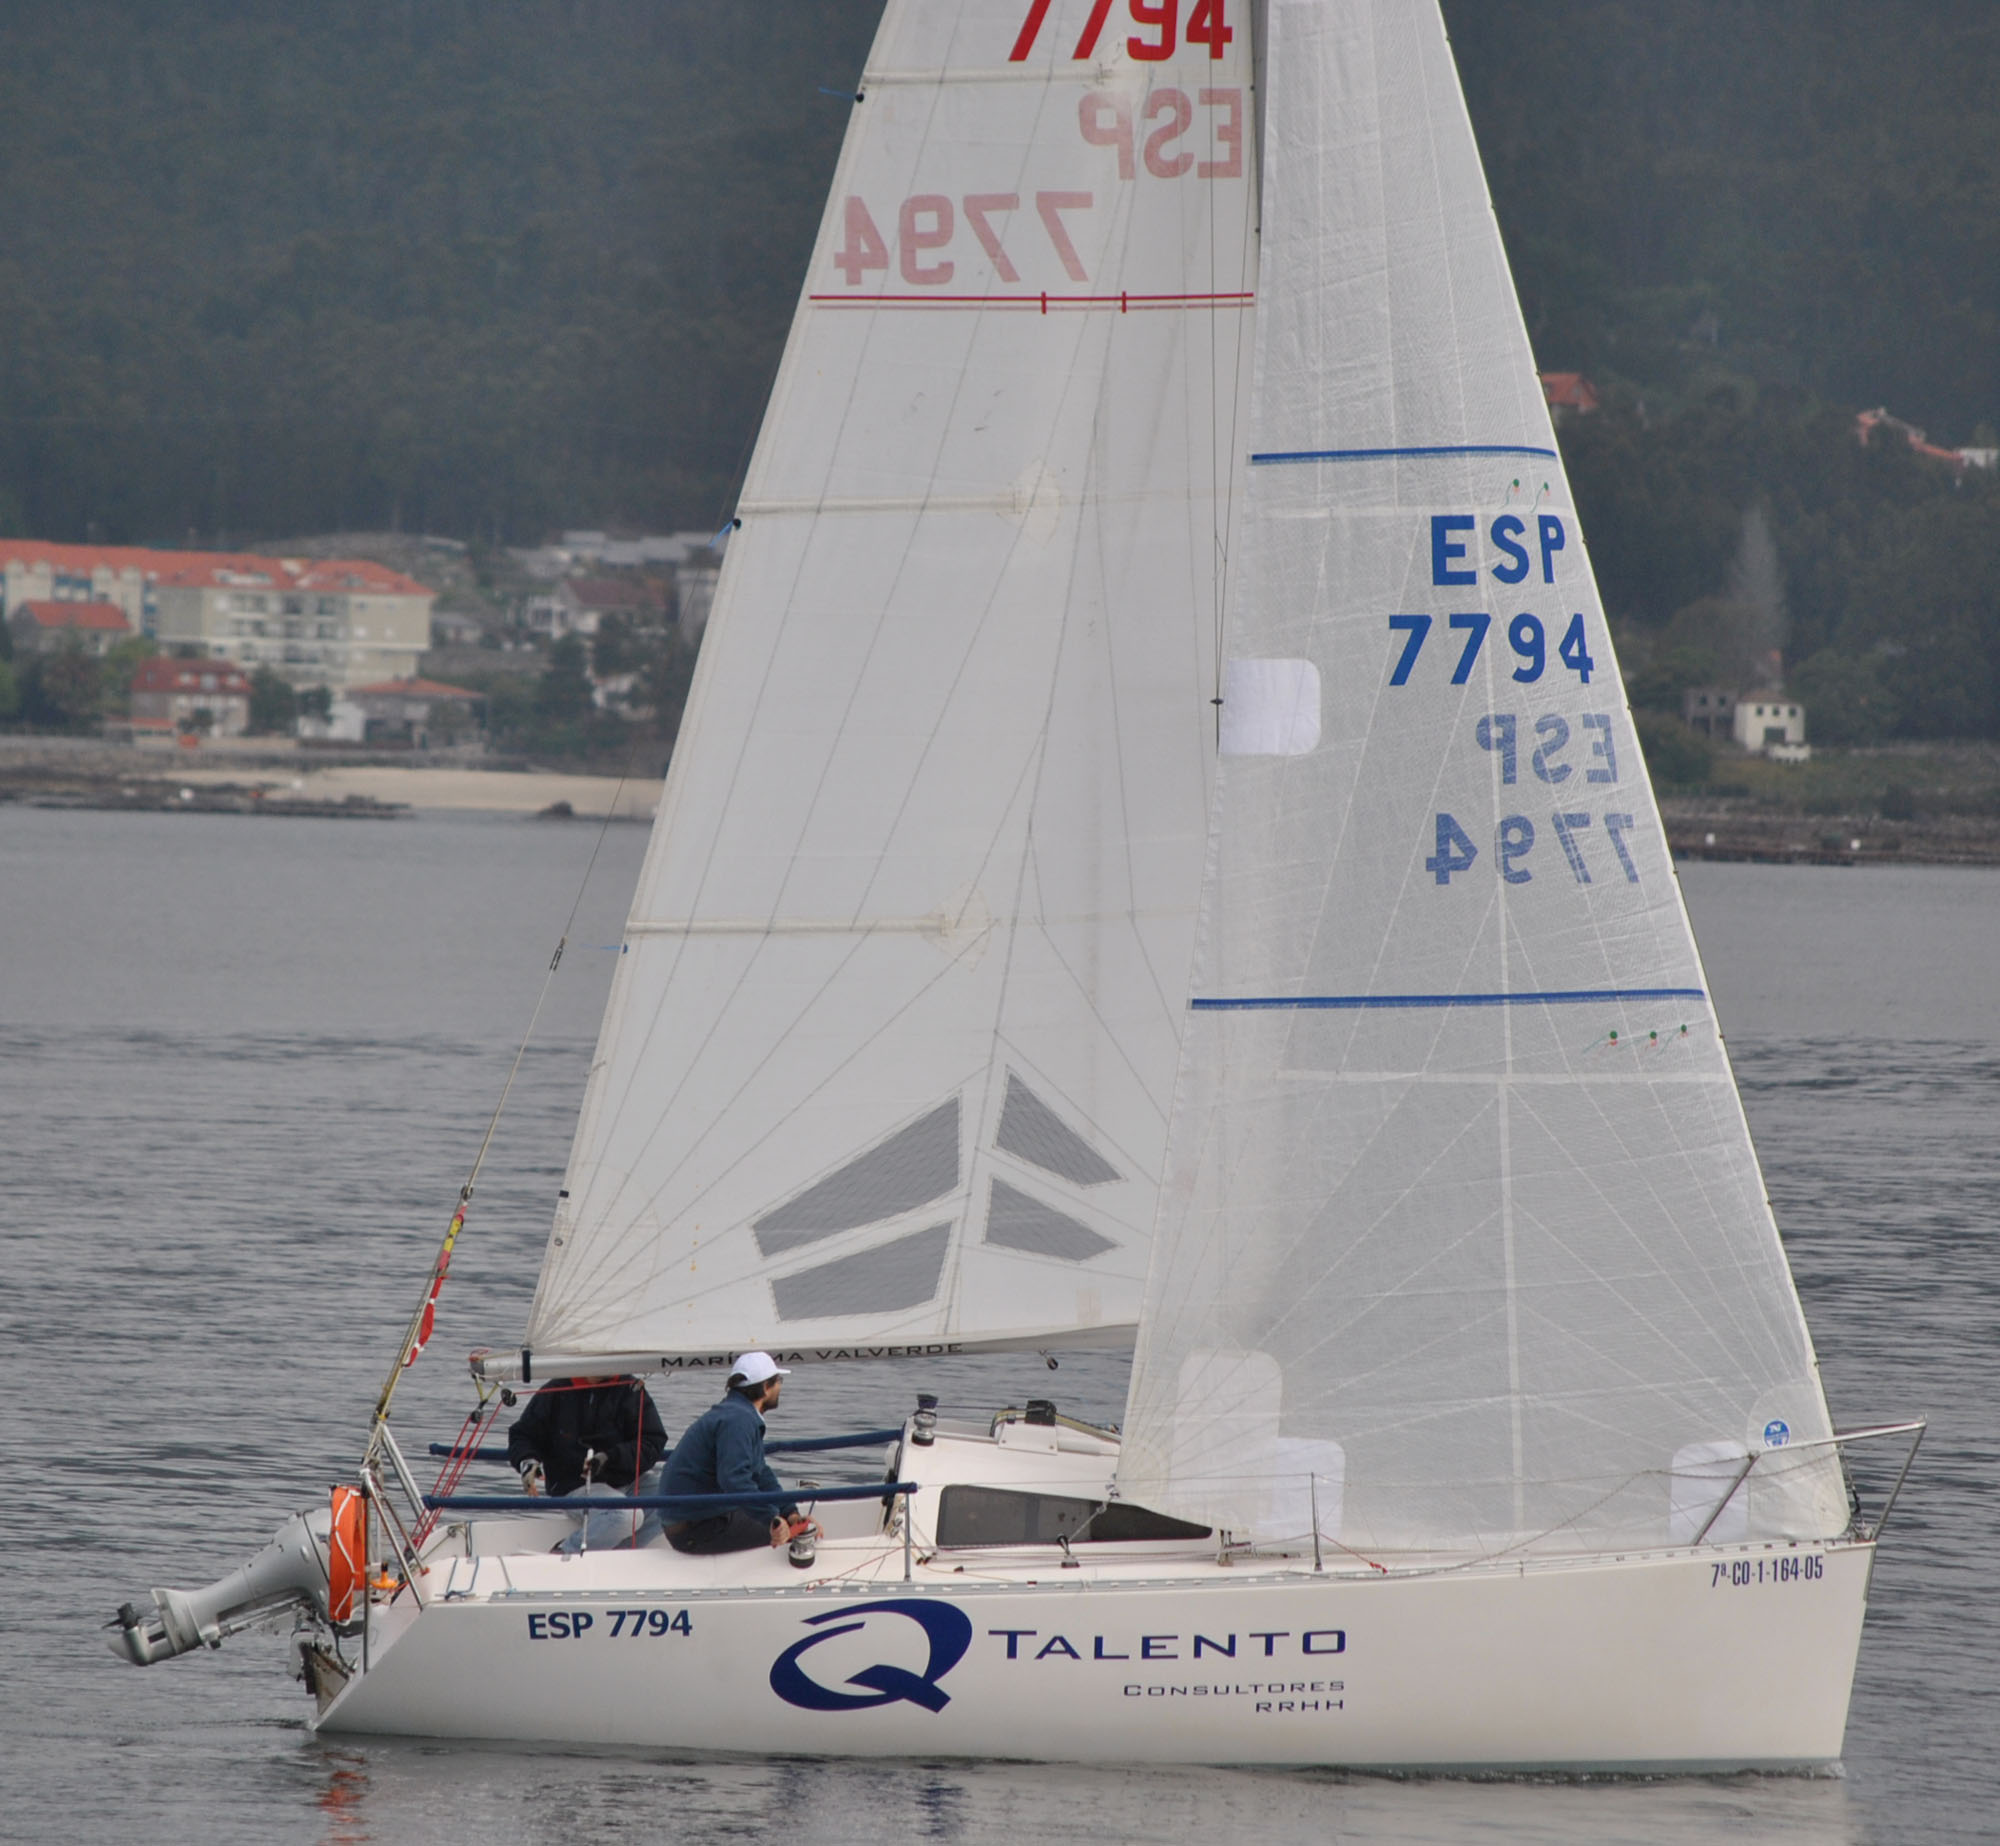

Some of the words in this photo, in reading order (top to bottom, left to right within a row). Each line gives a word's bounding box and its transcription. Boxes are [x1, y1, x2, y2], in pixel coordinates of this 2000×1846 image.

[1430, 514, 1566, 586] ESP
[1388, 612, 1595, 687] 7794
[661, 1352, 804, 1369] MARÍMA
[816, 1343, 963, 1361] VALVERDE
[527, 1612, 594, 1640] ESP
[605, 1609, 694, 1638] 7794
[988, 1630, 1346, 1660] TALENTO
[1123, 1680, 1345, 1697] CONSULTORES
[1255, 1699, 1344, 1713] RRHH
